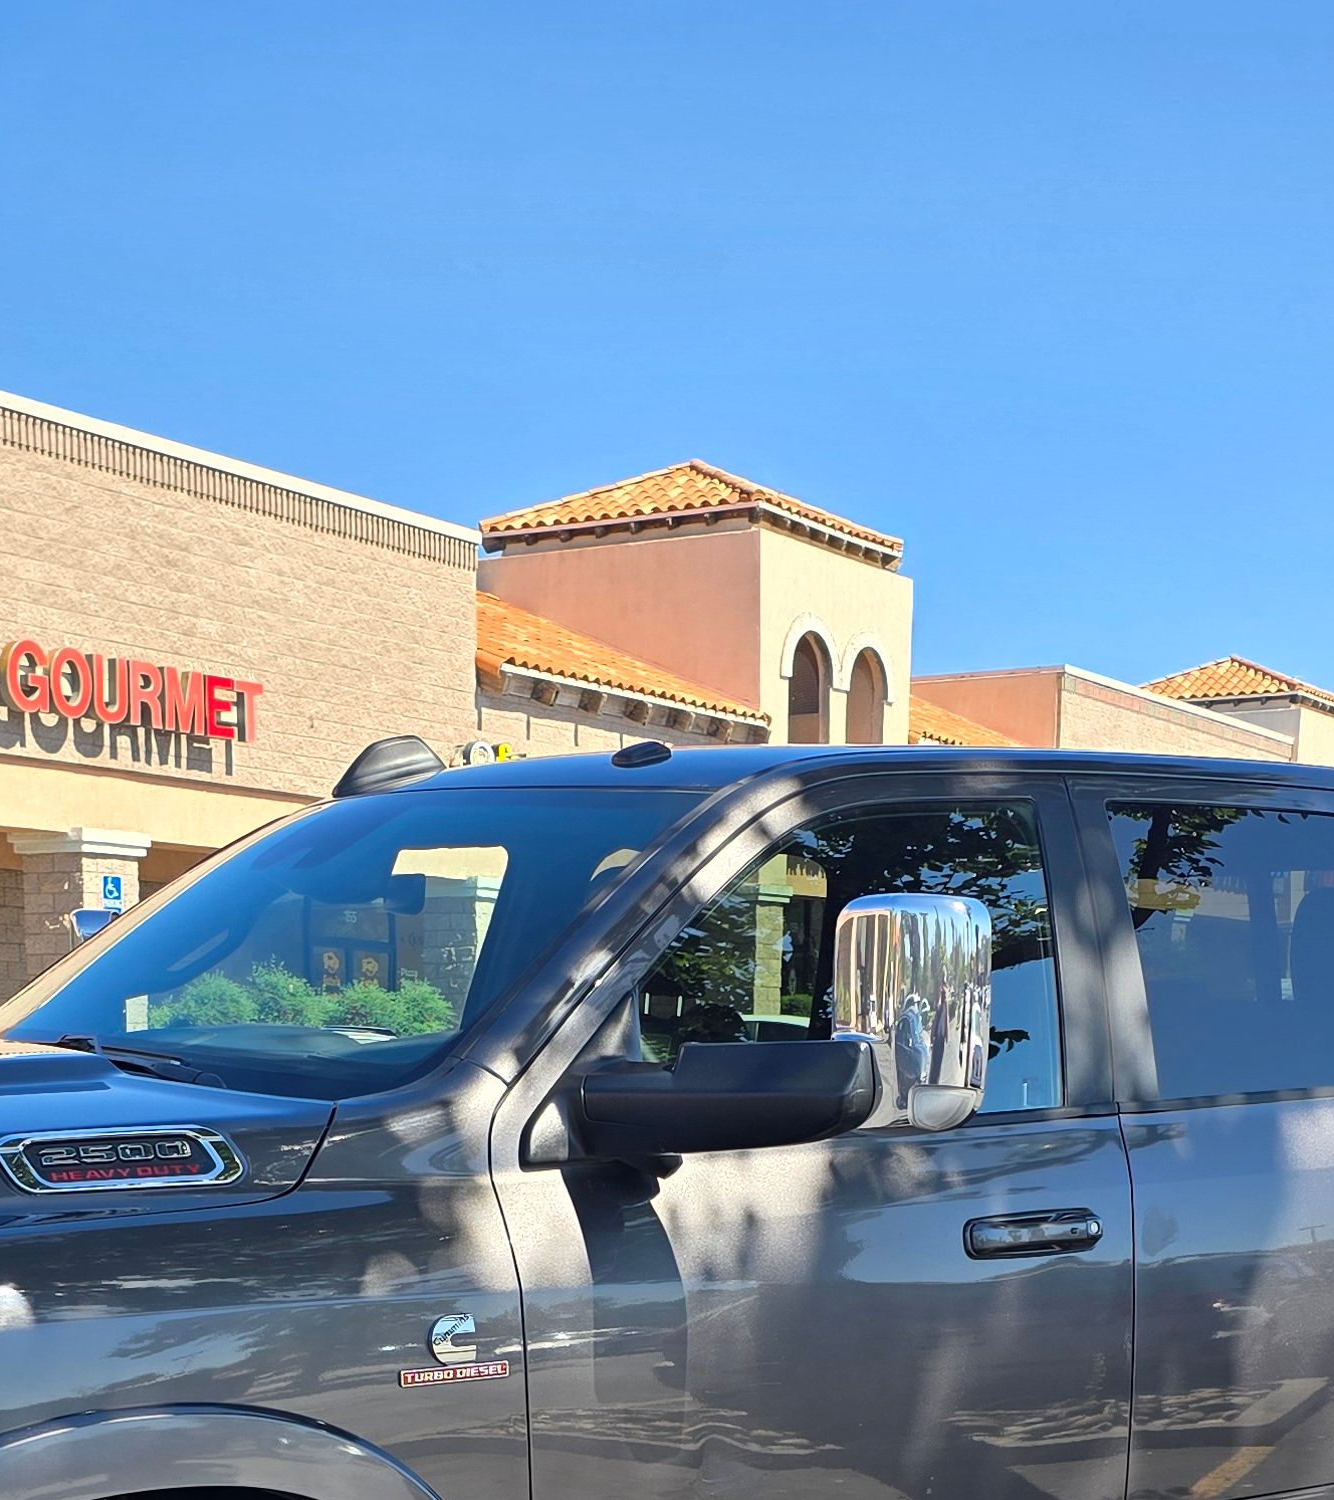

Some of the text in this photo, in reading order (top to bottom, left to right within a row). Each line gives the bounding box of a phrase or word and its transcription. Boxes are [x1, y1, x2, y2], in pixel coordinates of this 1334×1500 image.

[1, 639, 264, 744] GOURMET
[38, 1141, 192, 1166] 2500
[50, 1164, 201, 1181] HEAVY DUTY
[404, 1364, 506, 1384] TURBO DIESEL
